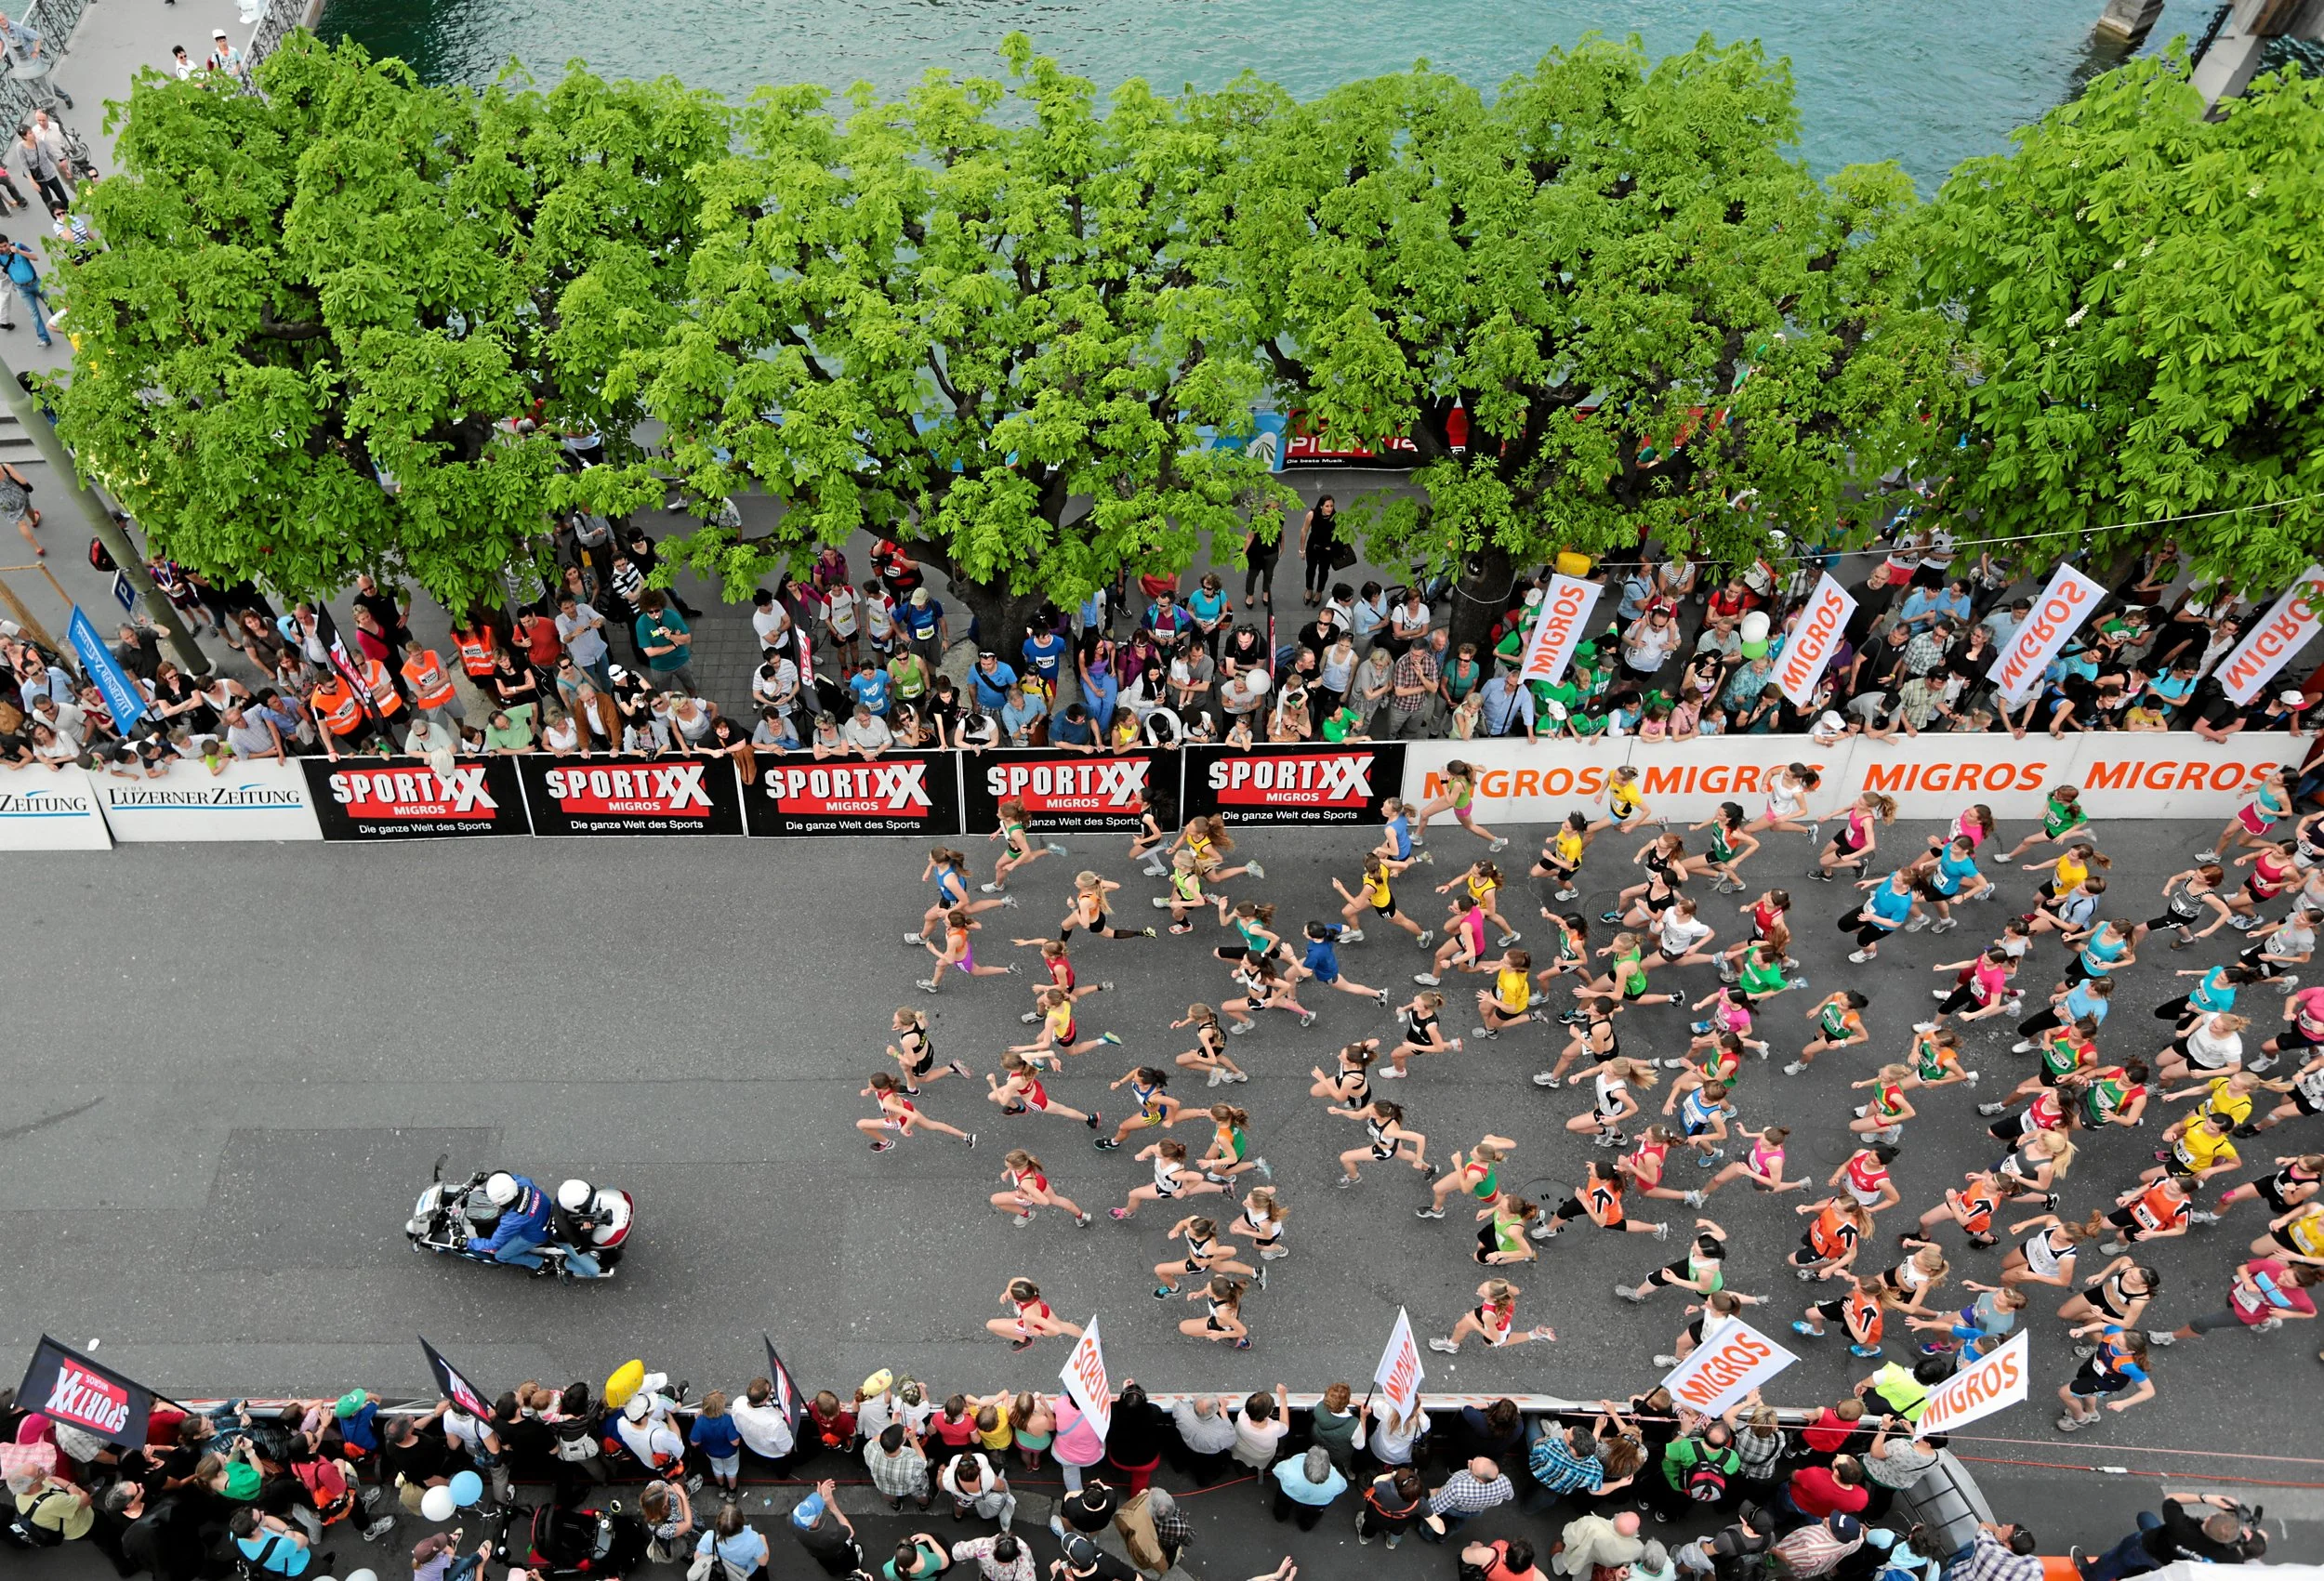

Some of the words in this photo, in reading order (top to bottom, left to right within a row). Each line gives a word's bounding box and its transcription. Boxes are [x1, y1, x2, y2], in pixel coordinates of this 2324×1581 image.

[1527, 584, 1586, 675] MIGROS
[1780, 587, 1844, 693] MIGROS
[1423, 767, 1603, 798] MGROS
[1643, 764, 1825, 793] MIGR
[1862, 761, 2049, 792] MIGROS
[2083, 760, 2278, 791] MIGROS
[0, 794, 87, 811] ZEITUNG
[108, 788, 209, 805] LUZERNER
[211, 788, 300, 804] ZEITUNG
[1046, 798, 1100, 809] MIGROS
[1266, 792, 1319, 802] MIGROS
[393, 805, 446, 815] MIGROS
[609, 801, 661, 811] MIGROS
[826, 801, 878, 811] MIGROS
[1058, 817, 1082, 826] Welt
[1084, 817, 1103, 826] des
[1105, 817, 1141, 827] Sports
[1221, 810, 1239, 821] Die
[1242, 812, 1274, 823] ganze
[1275, 810, 1299, 820] Welt
[1301, 810, 1320, 820] des
[1323, 810, 1358, 822] Sports
[359, 824, 376, 834] Die
[378, 825, 409, 836] ganze
[410, 823, 434, 833] Welt
[437, 823, 456, 832] des
[457, 822, 492, 832] Sports
[571, 820, 588, 830] Die
[590, 822, 621, 831] ganze
[622, 820, 646, 829] Welt
[648, 820, 667, 829] des
[669, 820, 704, 831] Sports
[786, 821, 803, 831] Die
[805, 823, 837, 832] ganze
[838, 821, 863, 829] Welt
[865, 820, 884, 829] des
[886, 820, 920, 831] Sports
[1677, 1332, 1771, 1405] MIGROS
[86, 1375, 109, 1392] MIGROS
[1073, 1337, 1111, 1423] MIGROS
[1921, 1351, 2019, 1429] MIGROS
